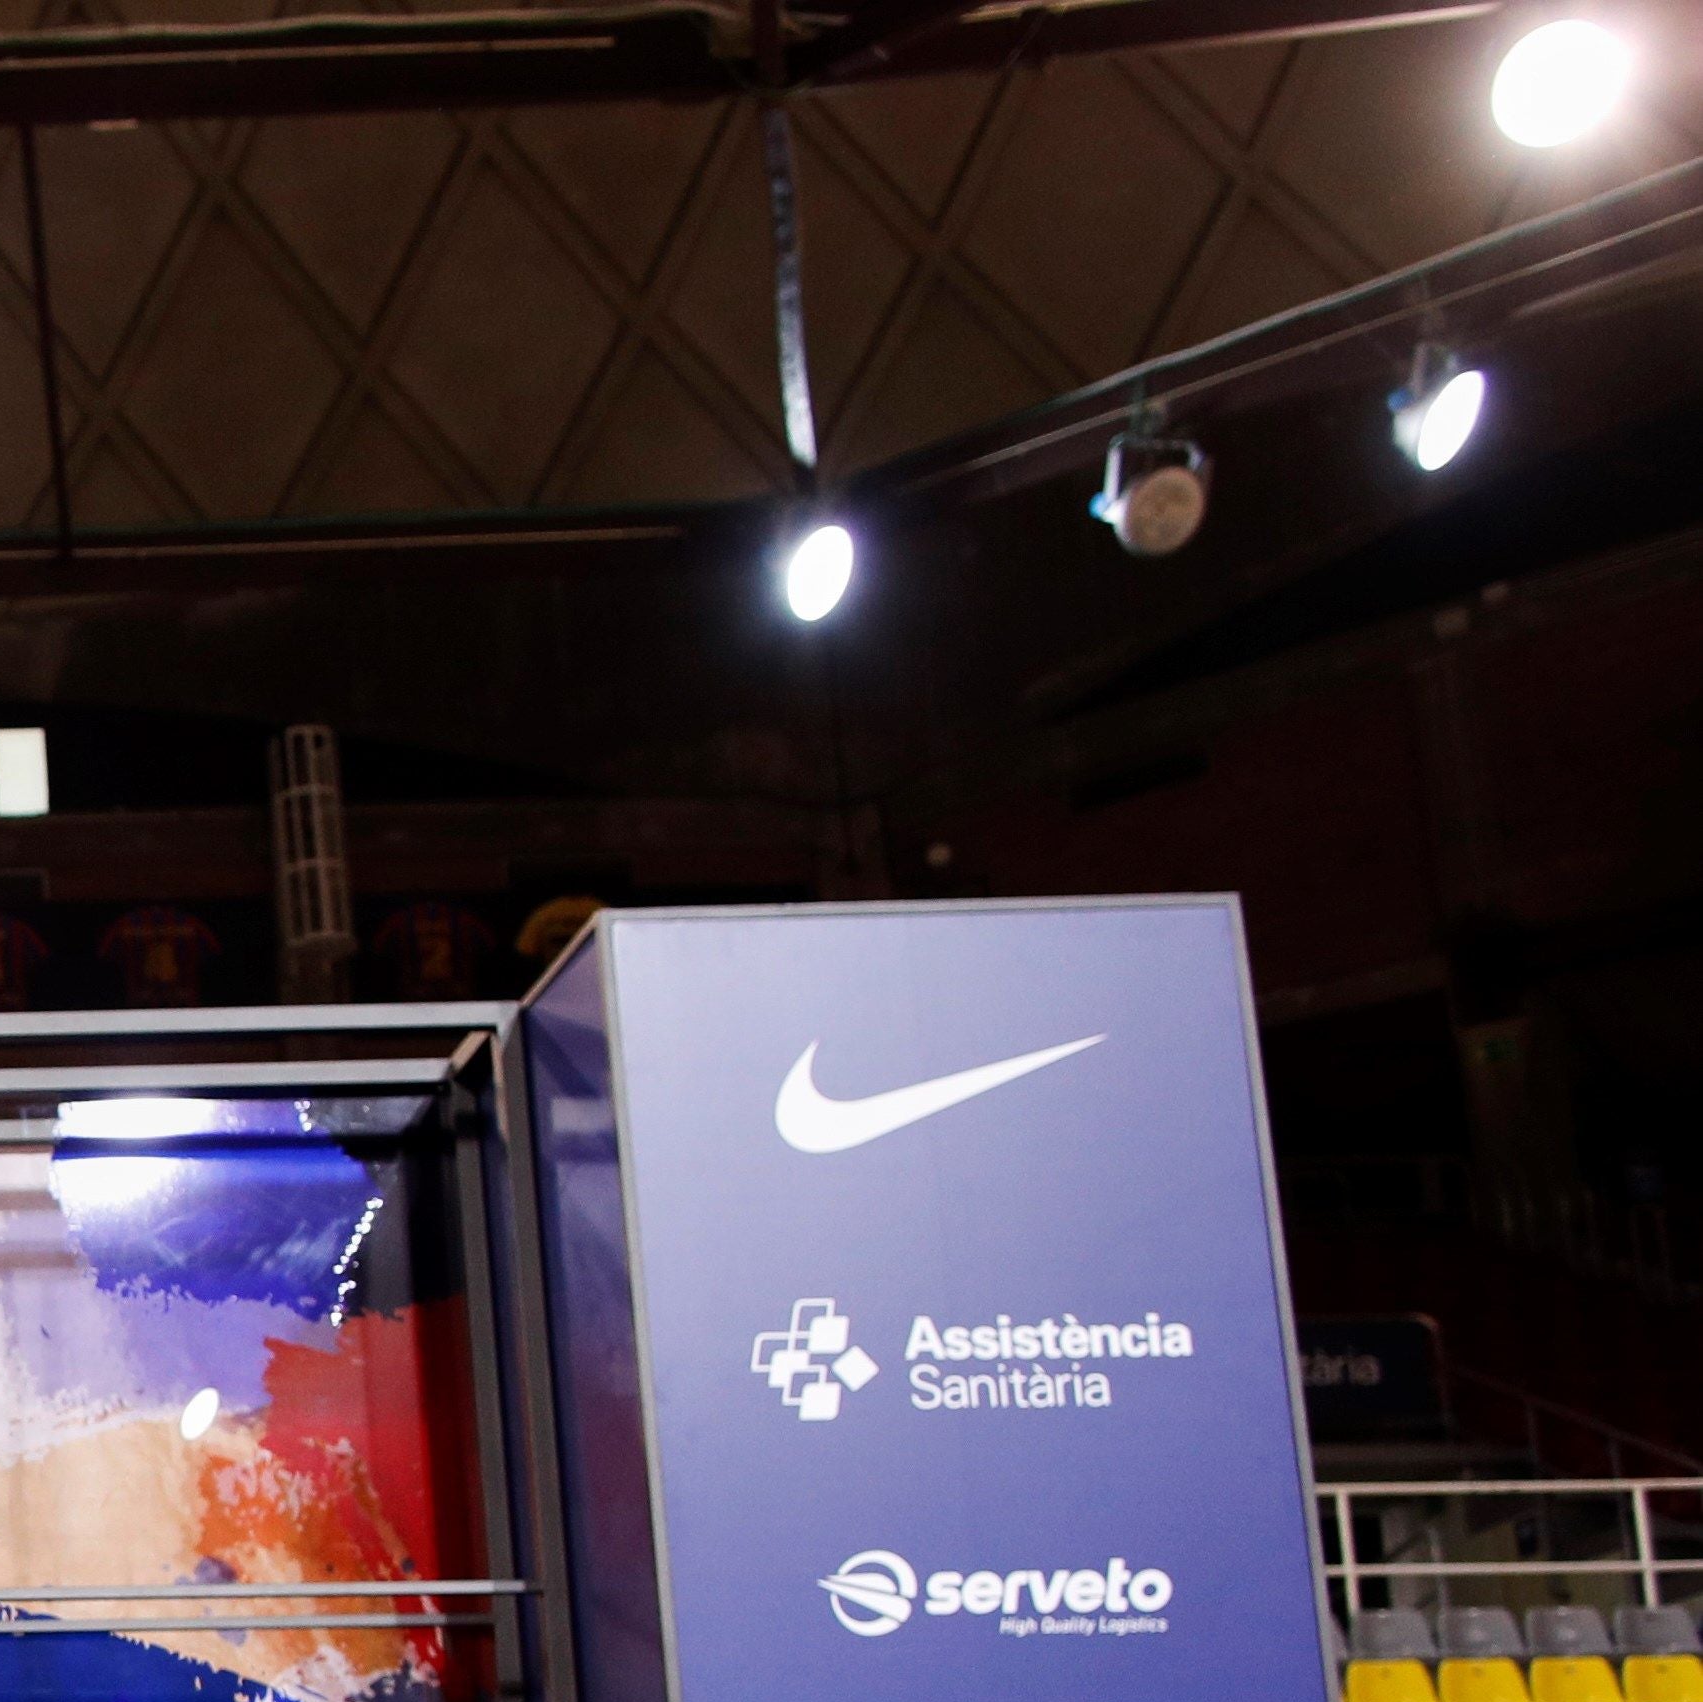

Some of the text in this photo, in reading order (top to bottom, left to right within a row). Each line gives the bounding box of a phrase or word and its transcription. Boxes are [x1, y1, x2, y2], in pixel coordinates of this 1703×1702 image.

[904, 1312, 1194, 1361] Assistència
[909, 1362, 1112, 1411] Sanitària
[924, 1557, 1174, 1616] serveto
[999, 1614, 1170, 1638] High Quality Logistics
